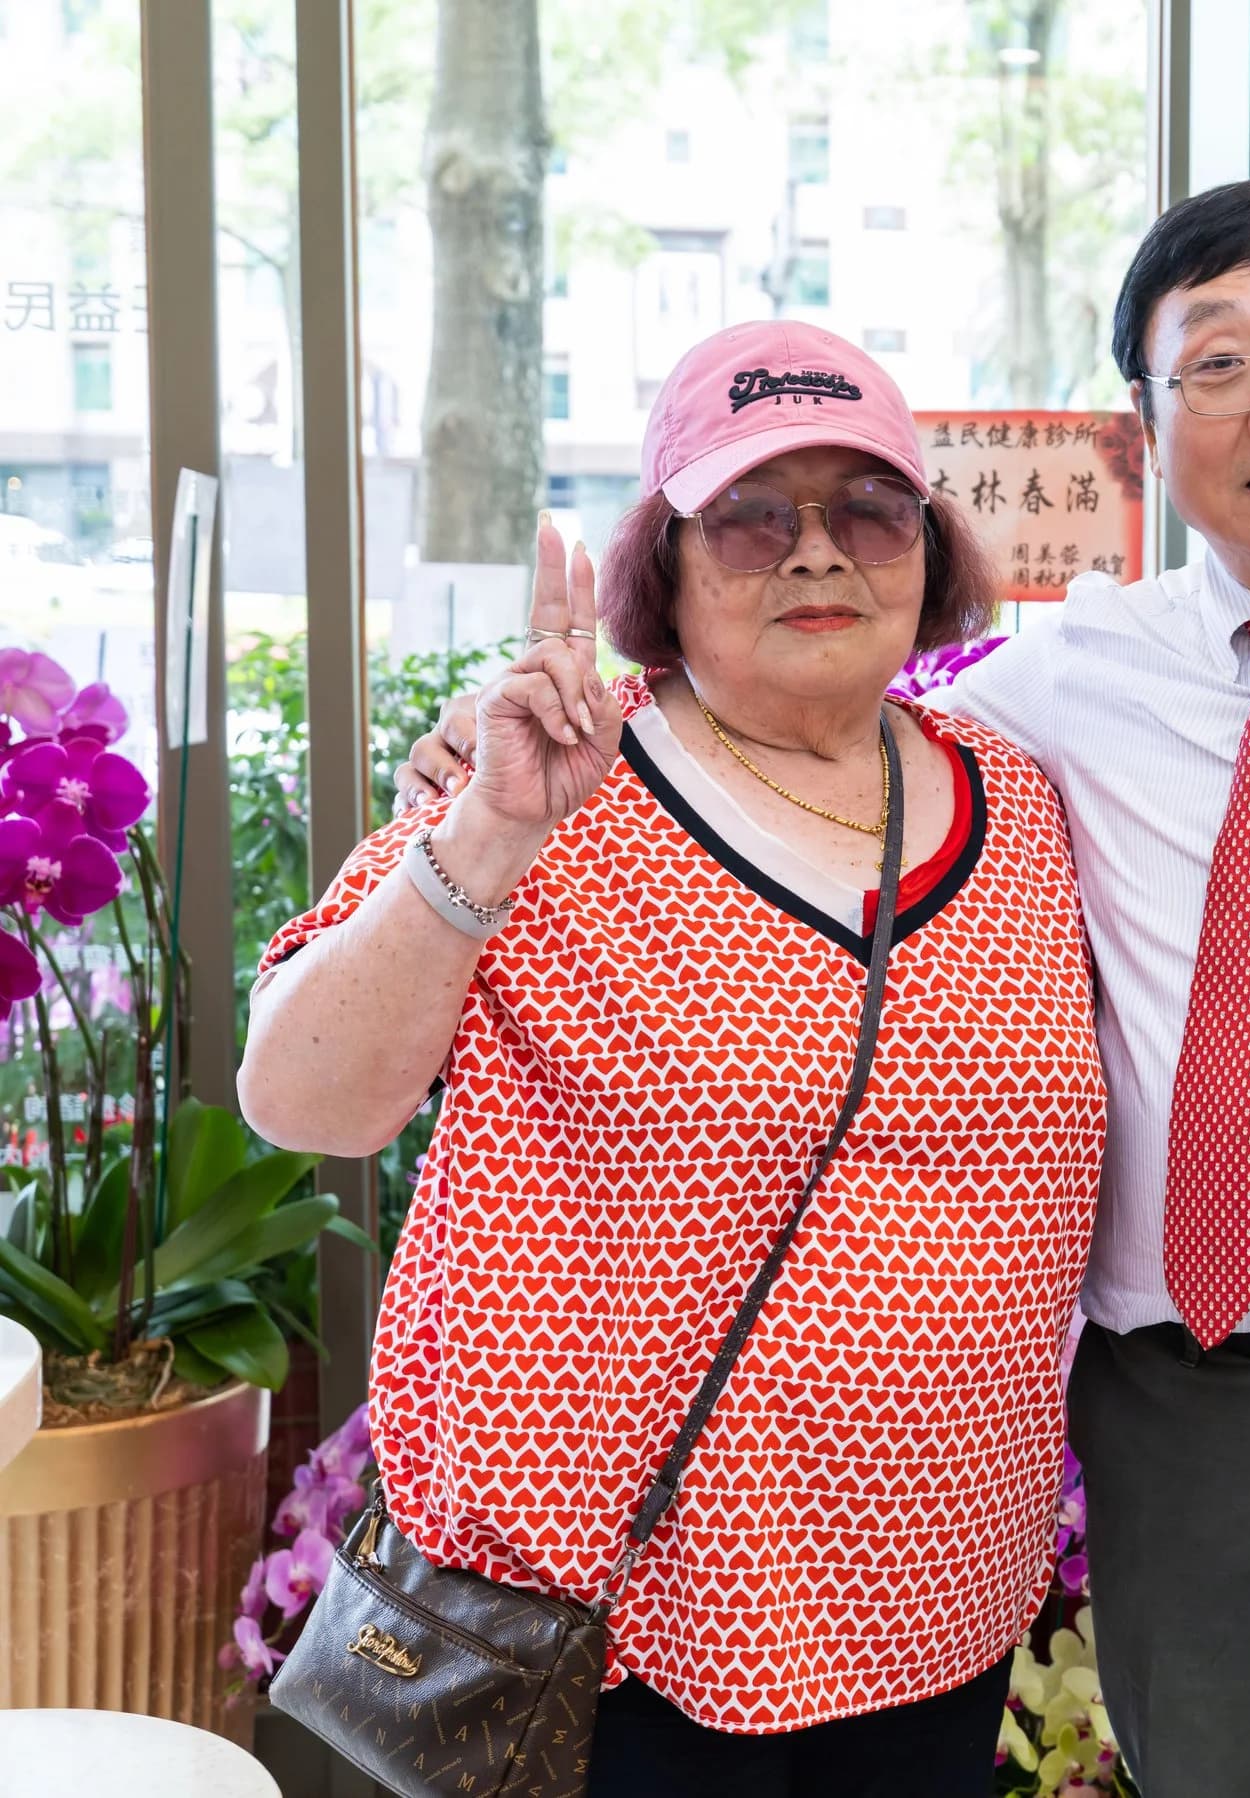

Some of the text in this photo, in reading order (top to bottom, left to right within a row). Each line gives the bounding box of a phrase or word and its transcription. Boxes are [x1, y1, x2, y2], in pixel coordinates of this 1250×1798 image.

[930, 420, 1099, 449] 益民健康診所
